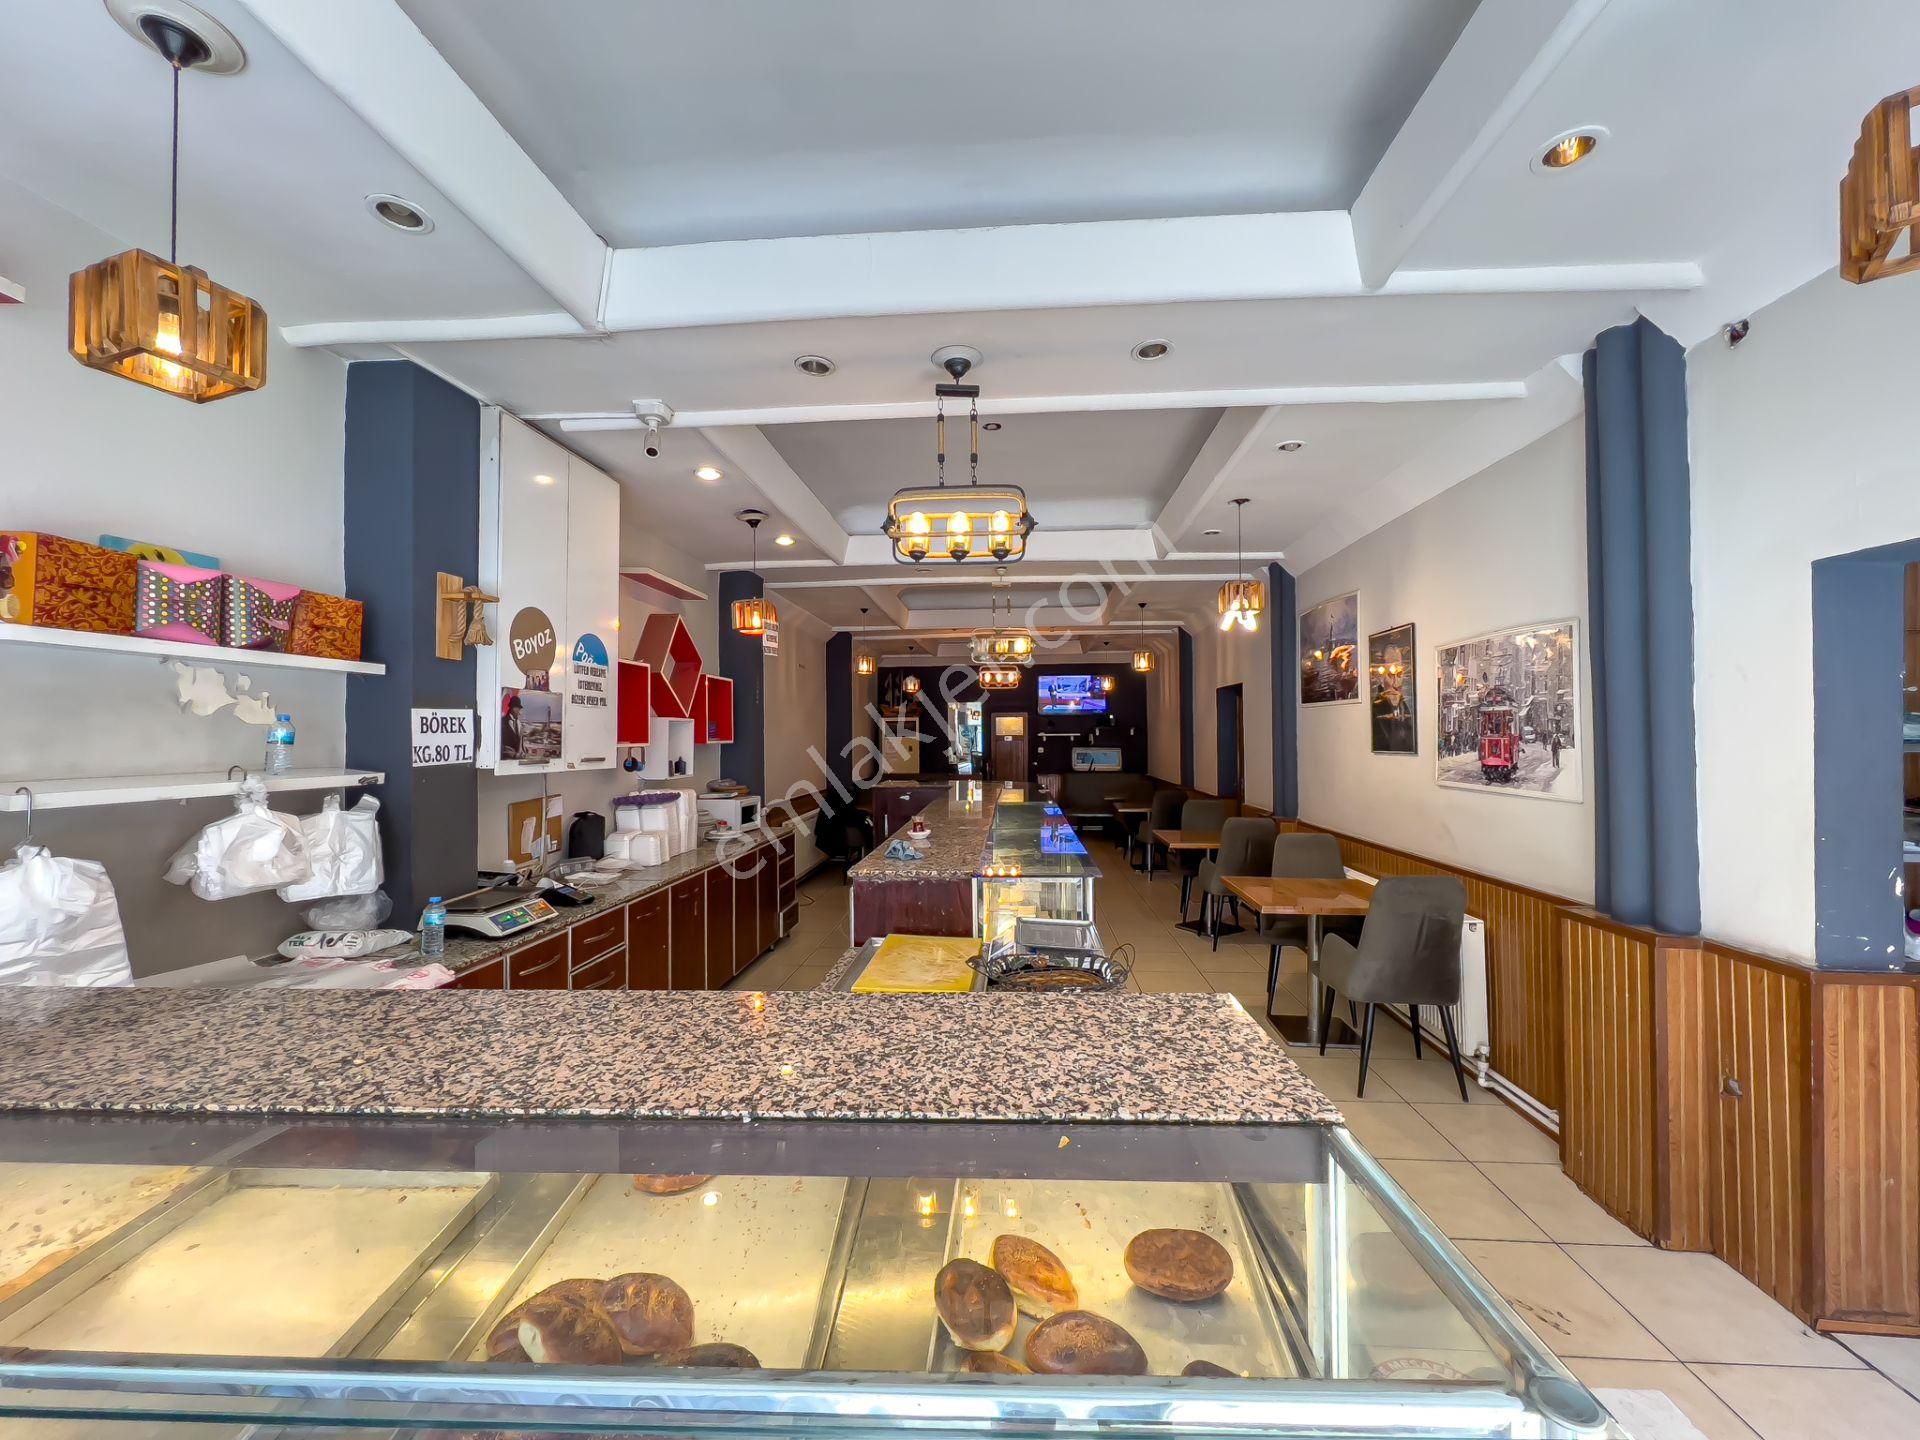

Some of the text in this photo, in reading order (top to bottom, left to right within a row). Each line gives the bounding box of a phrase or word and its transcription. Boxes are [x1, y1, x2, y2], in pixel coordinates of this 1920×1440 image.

[420, 712, 467, 734] BÖREK
[413, 744, 472, 764] KG.80 TL.
